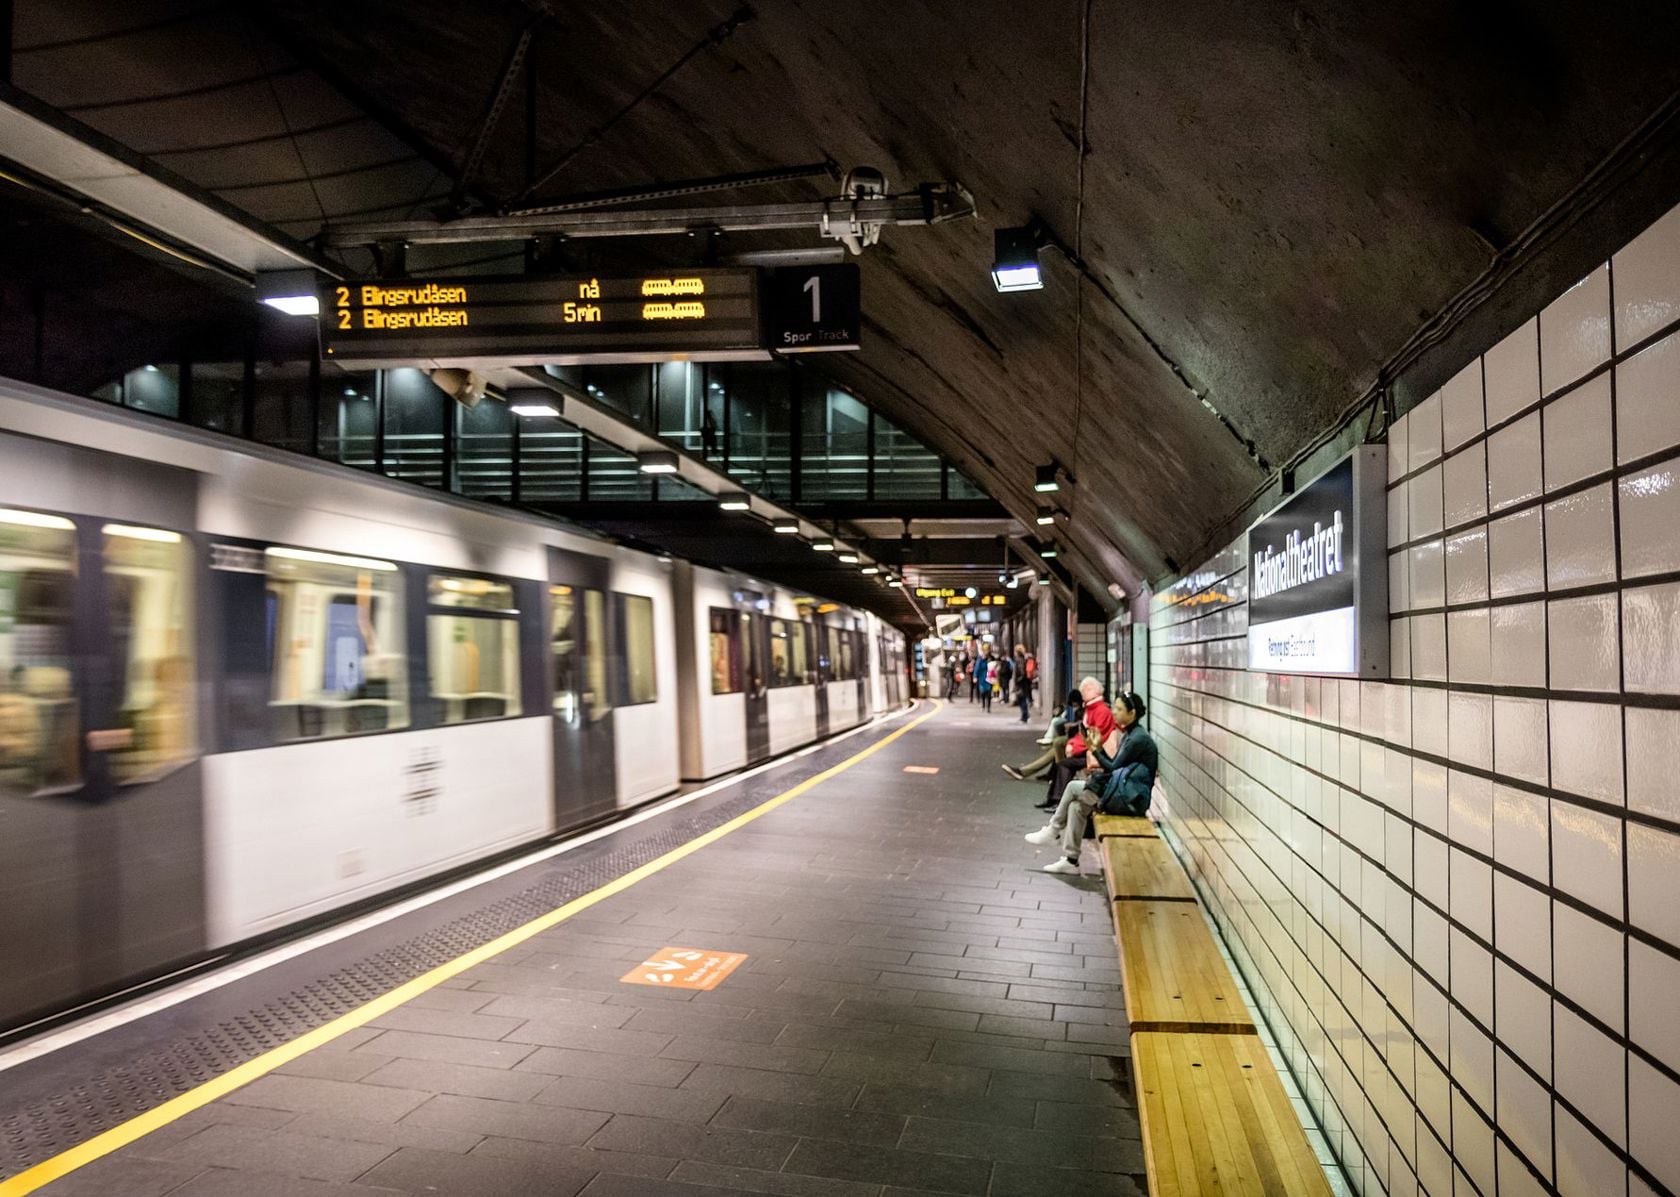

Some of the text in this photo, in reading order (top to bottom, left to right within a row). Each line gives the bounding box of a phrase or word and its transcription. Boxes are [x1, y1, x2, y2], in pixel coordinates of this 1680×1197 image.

[336, 286, 350, 307] 2
[579, 278, 600, 298] nå
[803, 276, 820, 322] 1
[338, 309, 352, 329] 2
[783, 329, 849, 344] Spor Track
[1254, 510, 1344, 600] Nationaltheatret
